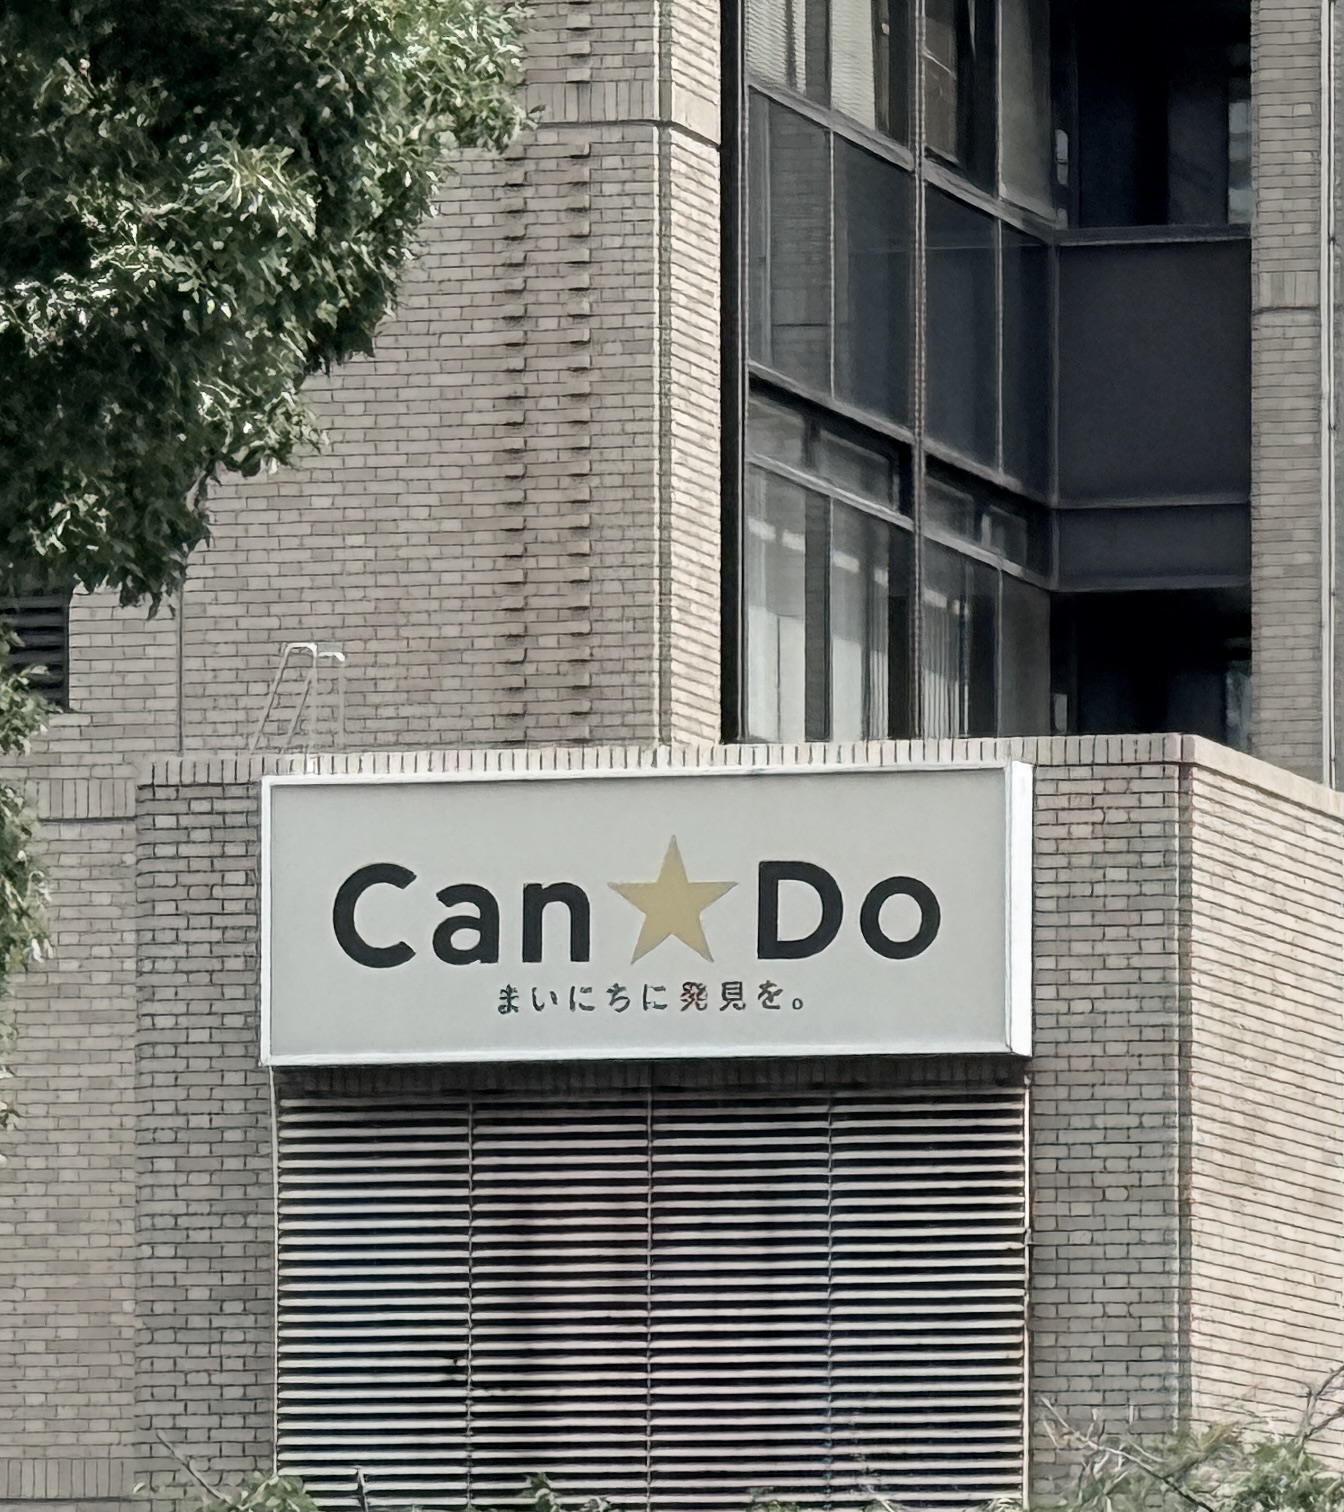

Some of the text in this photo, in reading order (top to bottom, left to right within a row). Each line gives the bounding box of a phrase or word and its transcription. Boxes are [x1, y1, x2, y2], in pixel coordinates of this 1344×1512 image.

[332, 859, 942, 970] Can Do
[496, 980, 805, 1016] まいにちに発見を。
